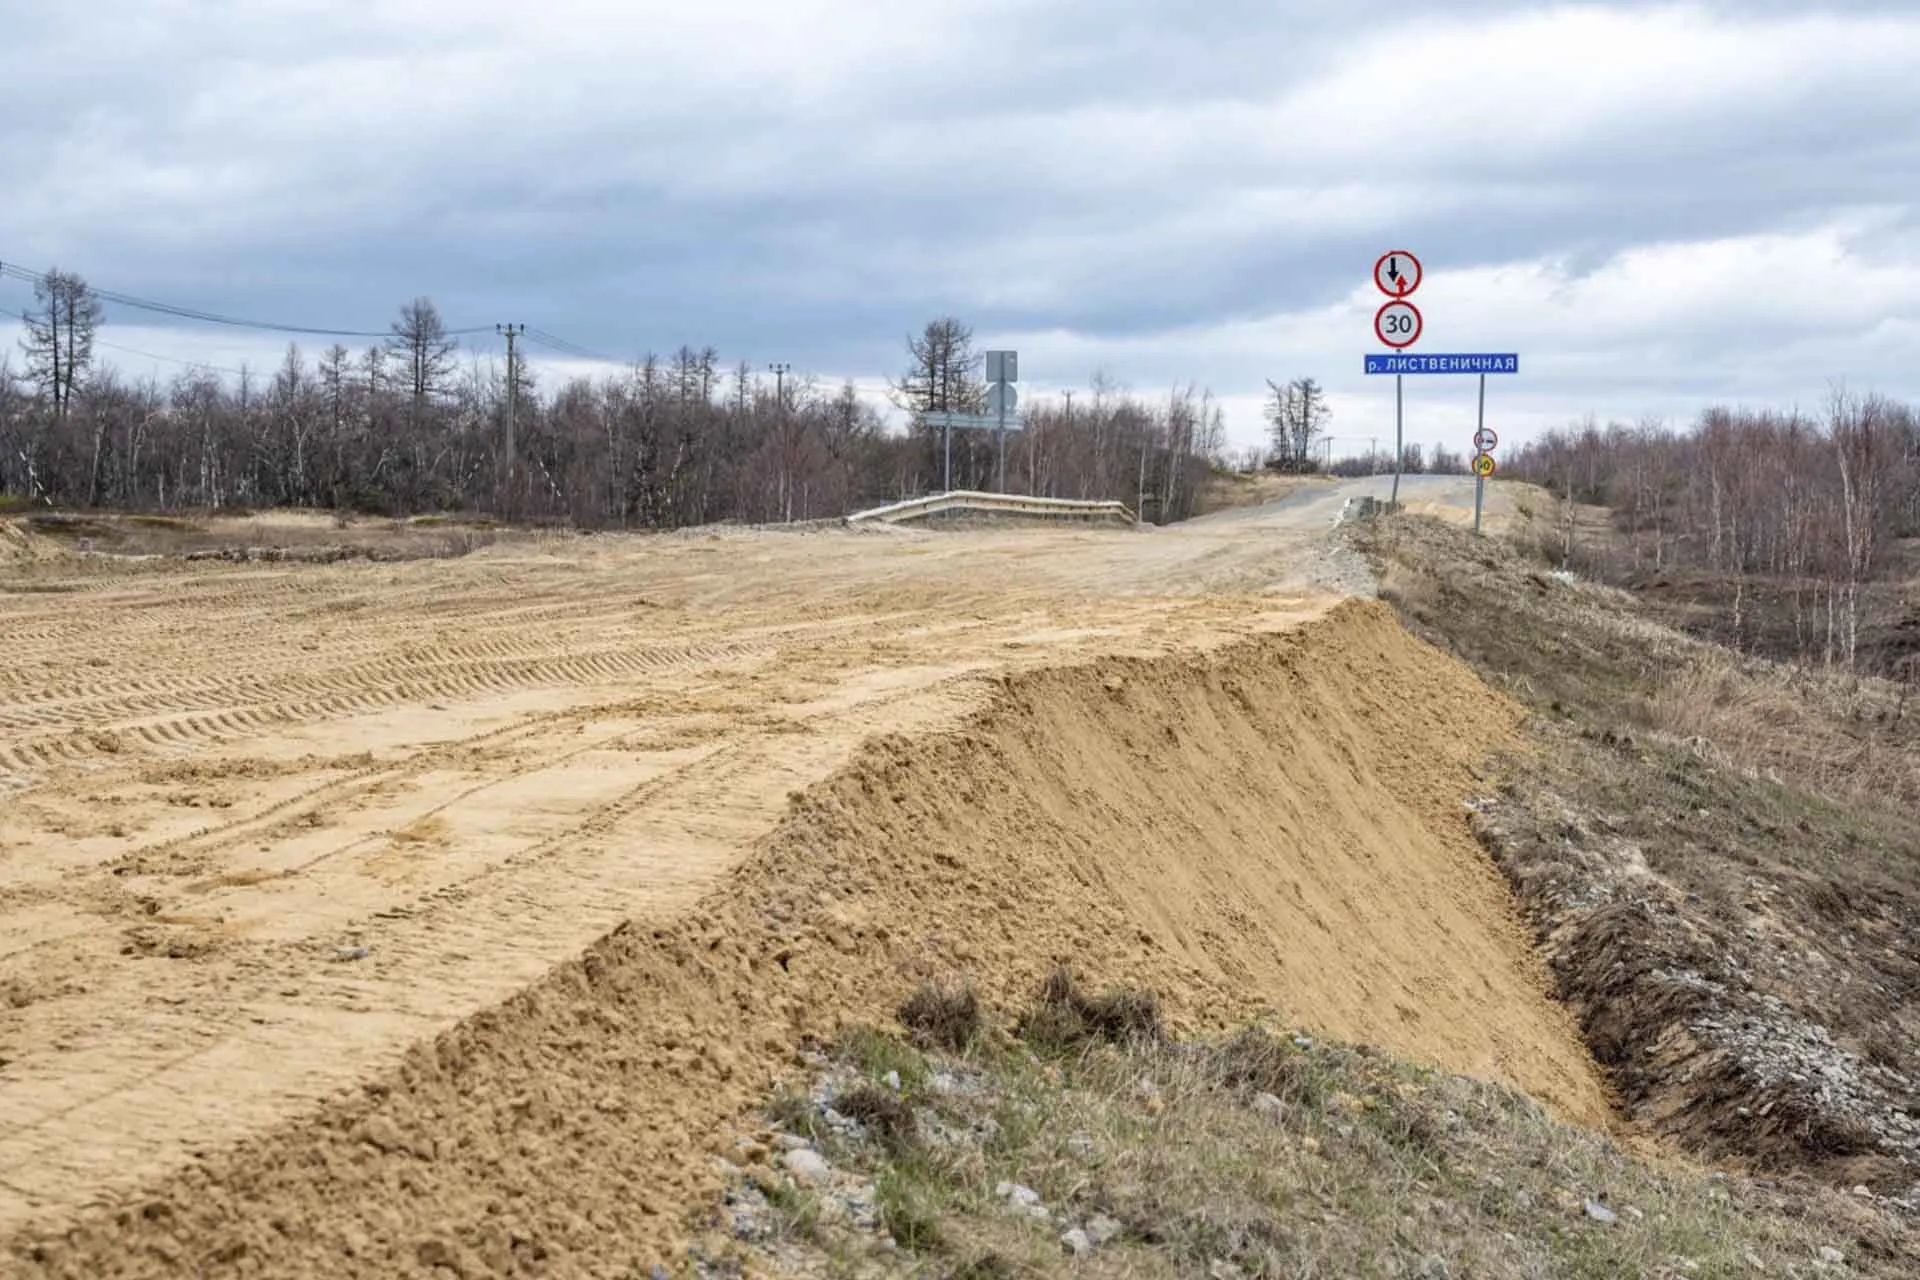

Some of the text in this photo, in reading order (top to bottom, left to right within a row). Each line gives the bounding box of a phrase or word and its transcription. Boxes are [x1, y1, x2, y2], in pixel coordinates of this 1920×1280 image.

[1386, 315, 1412, 334] 30
[1368, 357, 1515, 372] р. ЛИСТВЕНИЧНАЯ
